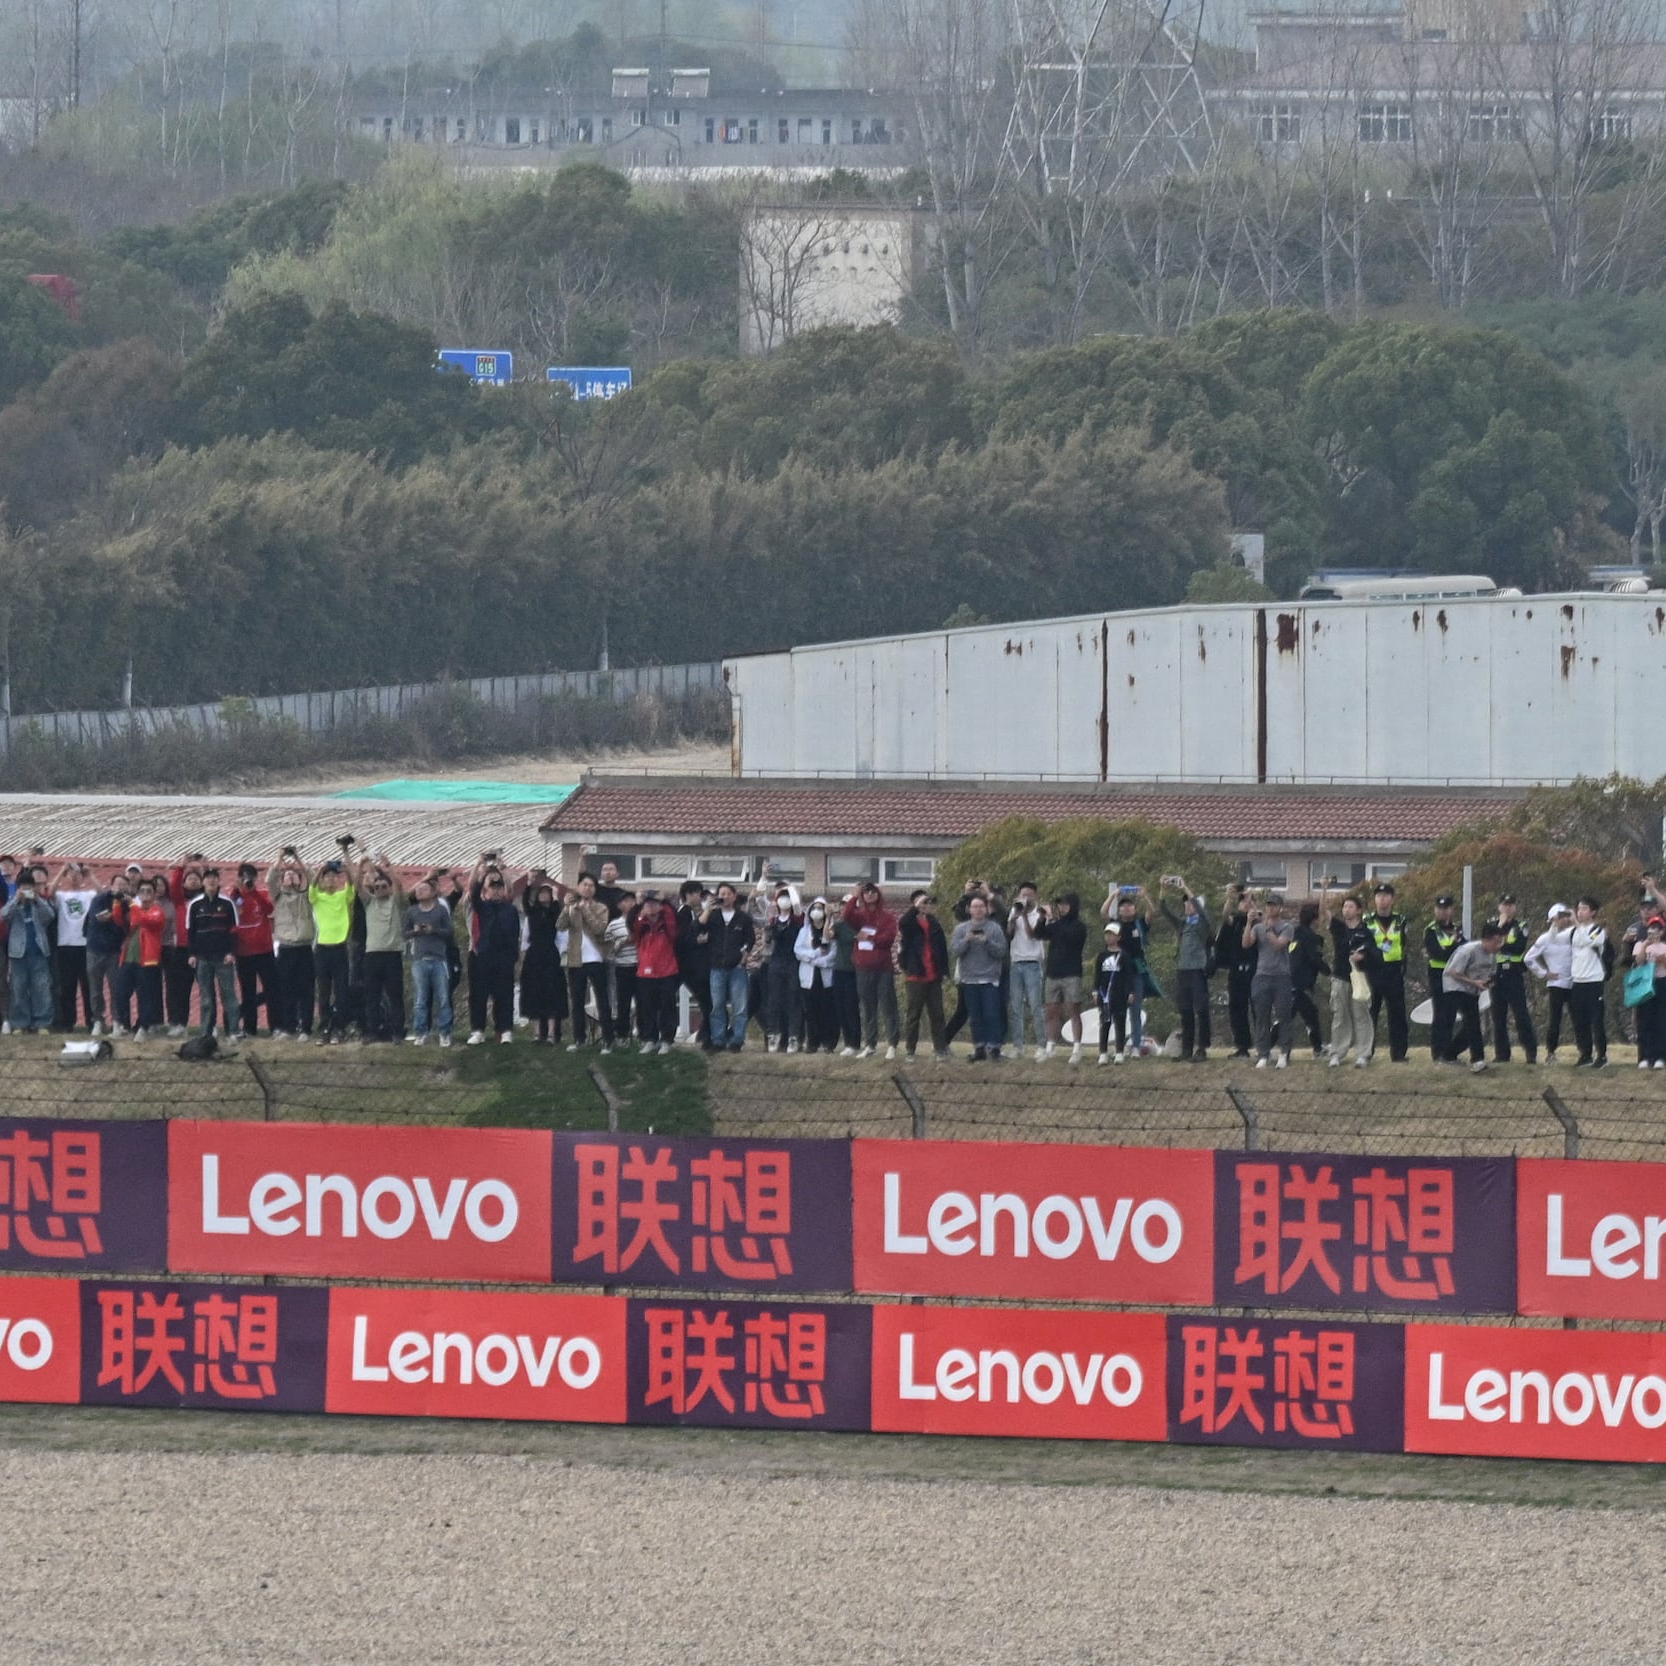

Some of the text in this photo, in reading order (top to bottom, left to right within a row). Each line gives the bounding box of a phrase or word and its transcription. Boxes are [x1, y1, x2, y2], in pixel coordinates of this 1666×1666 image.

[202, 1154, 519, 1242] Lenovo
[573, 1144, 793, 1280] 联想
[884, 1172, 1183, 1263] Lenovo
[1235, 1164, 1455, 1300] 联想
[97, 1290, 278, 1399] 联想
[352, 1315, 601, 1389] Lenovo
[644, 1308, 827, 1418] 联想
[900, 1333, 1143, 1406] Lenovo
[1180, 1325, 1355, 1438] 联想
